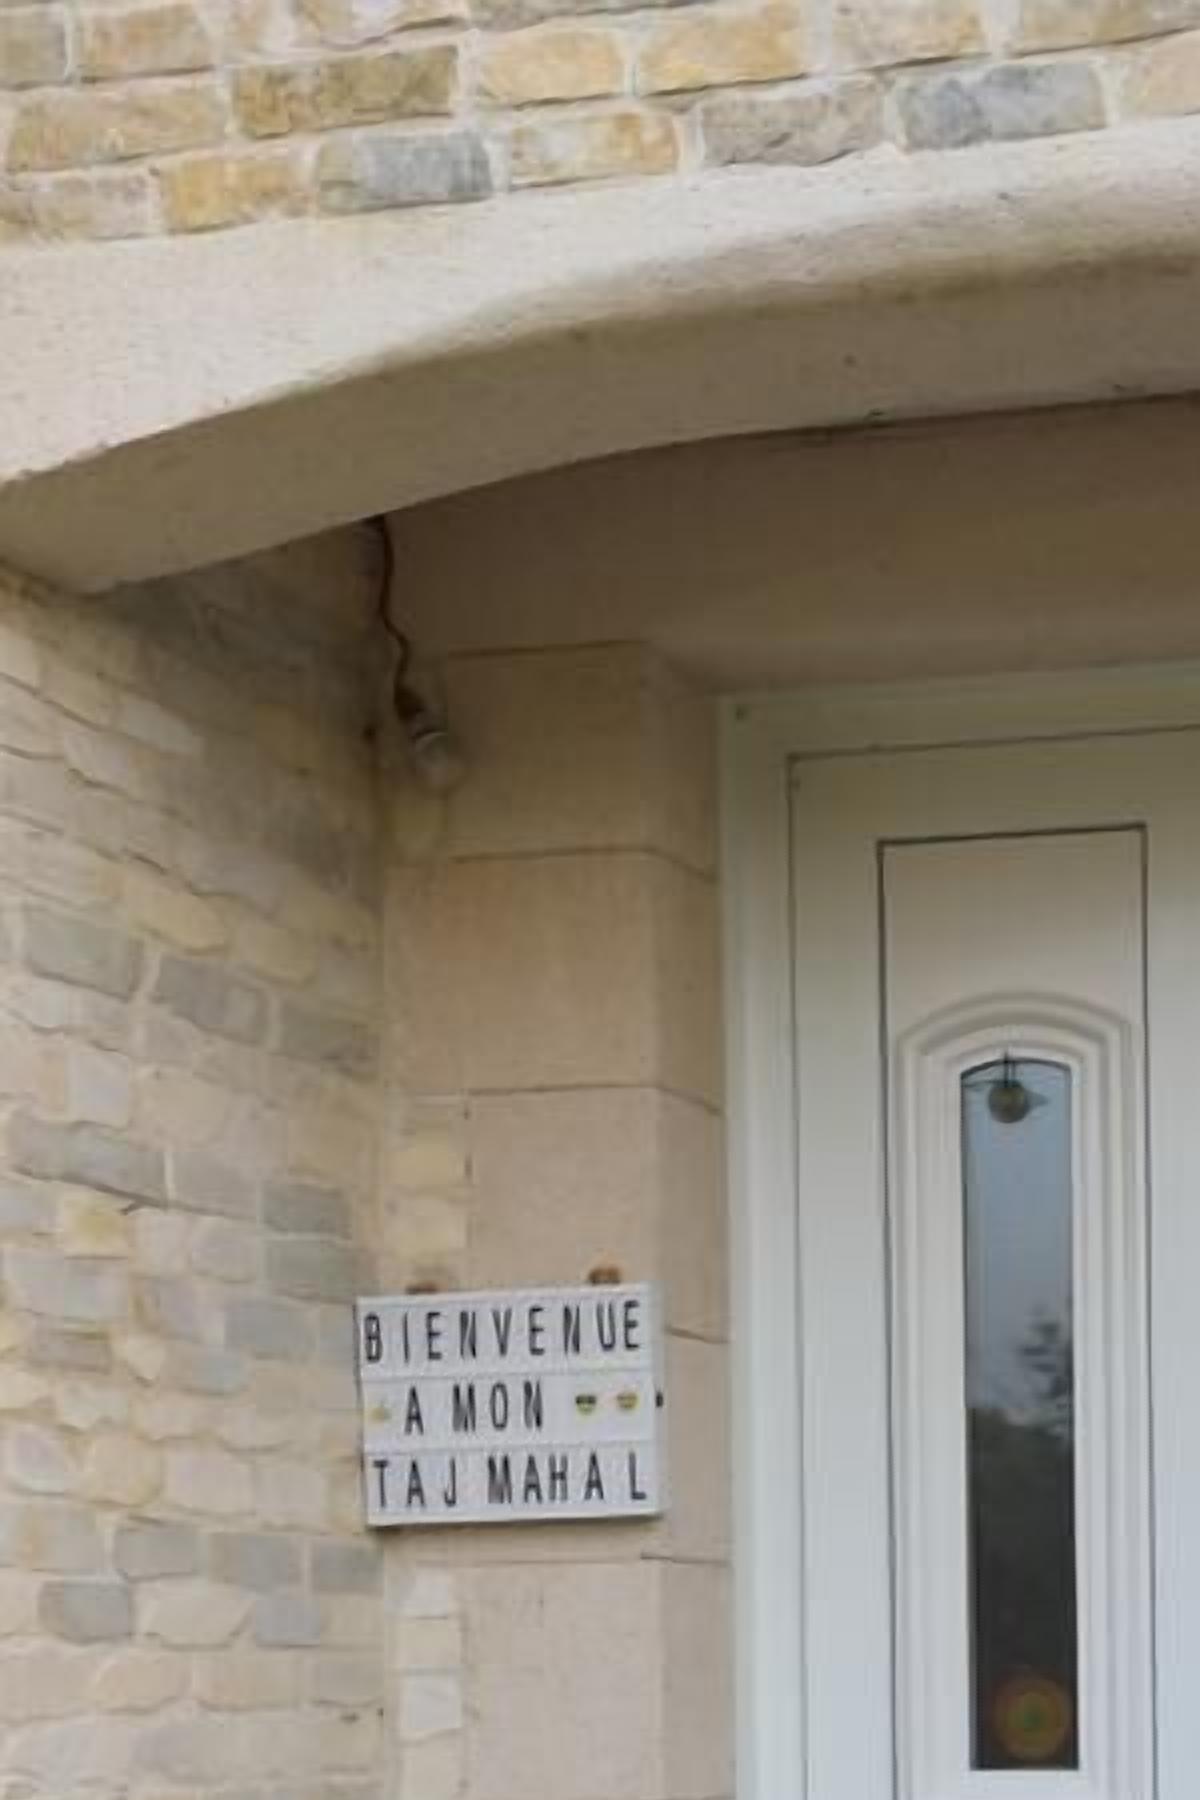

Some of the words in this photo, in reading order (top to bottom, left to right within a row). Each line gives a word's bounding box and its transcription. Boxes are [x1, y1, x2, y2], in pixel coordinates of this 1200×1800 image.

[363, 1299, 641, 1364] BIENVENUE
[404, 1384, 425, 1435] A
[452, 1378, 544, 1433] MON
[372, 1455, 458, 1509] TAJ
[487, 1449, 648, 1505] MAHAL
